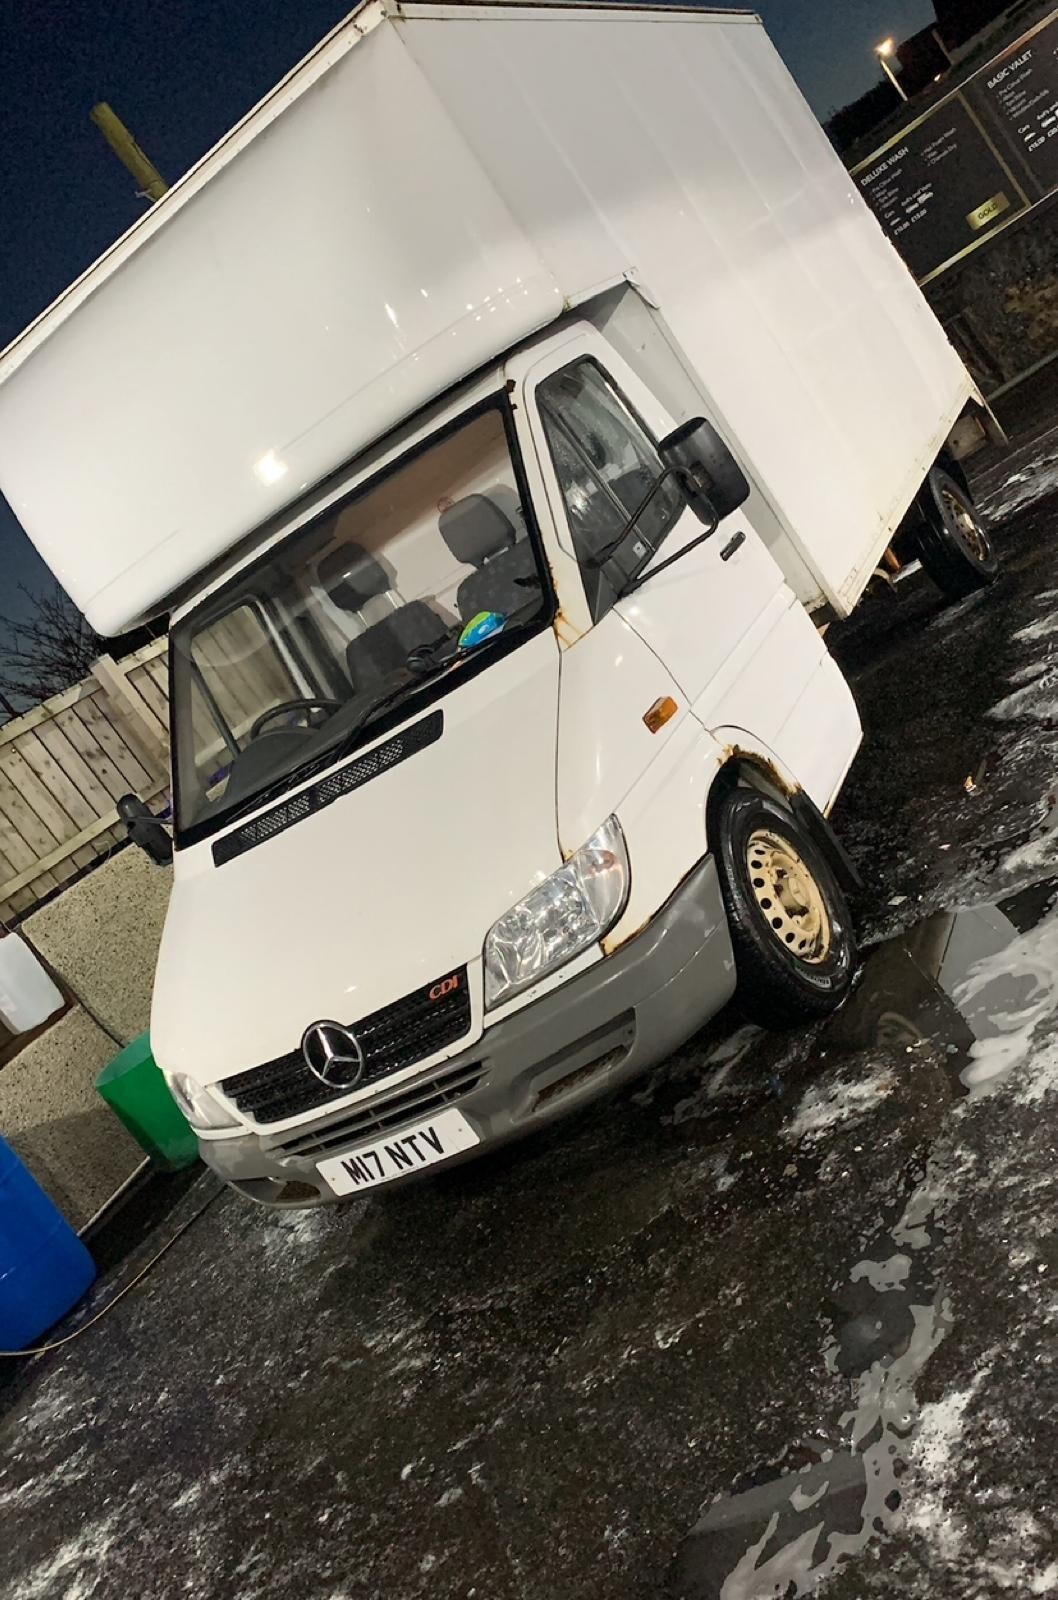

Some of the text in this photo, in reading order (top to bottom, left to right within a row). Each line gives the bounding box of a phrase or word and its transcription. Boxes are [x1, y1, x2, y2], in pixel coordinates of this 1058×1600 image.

[987, 68, 1010, 89] BASIC
[1008, 49, 1032, 71] VALET
[861, 162, 888, 186] DELUXE
[887, 146, 909, 166] WASH
[978, 202, 998, 220] GOLD
[429, 975, 459, 1000] CDI
[340, 1126, 445, 1186] M17 NTV
